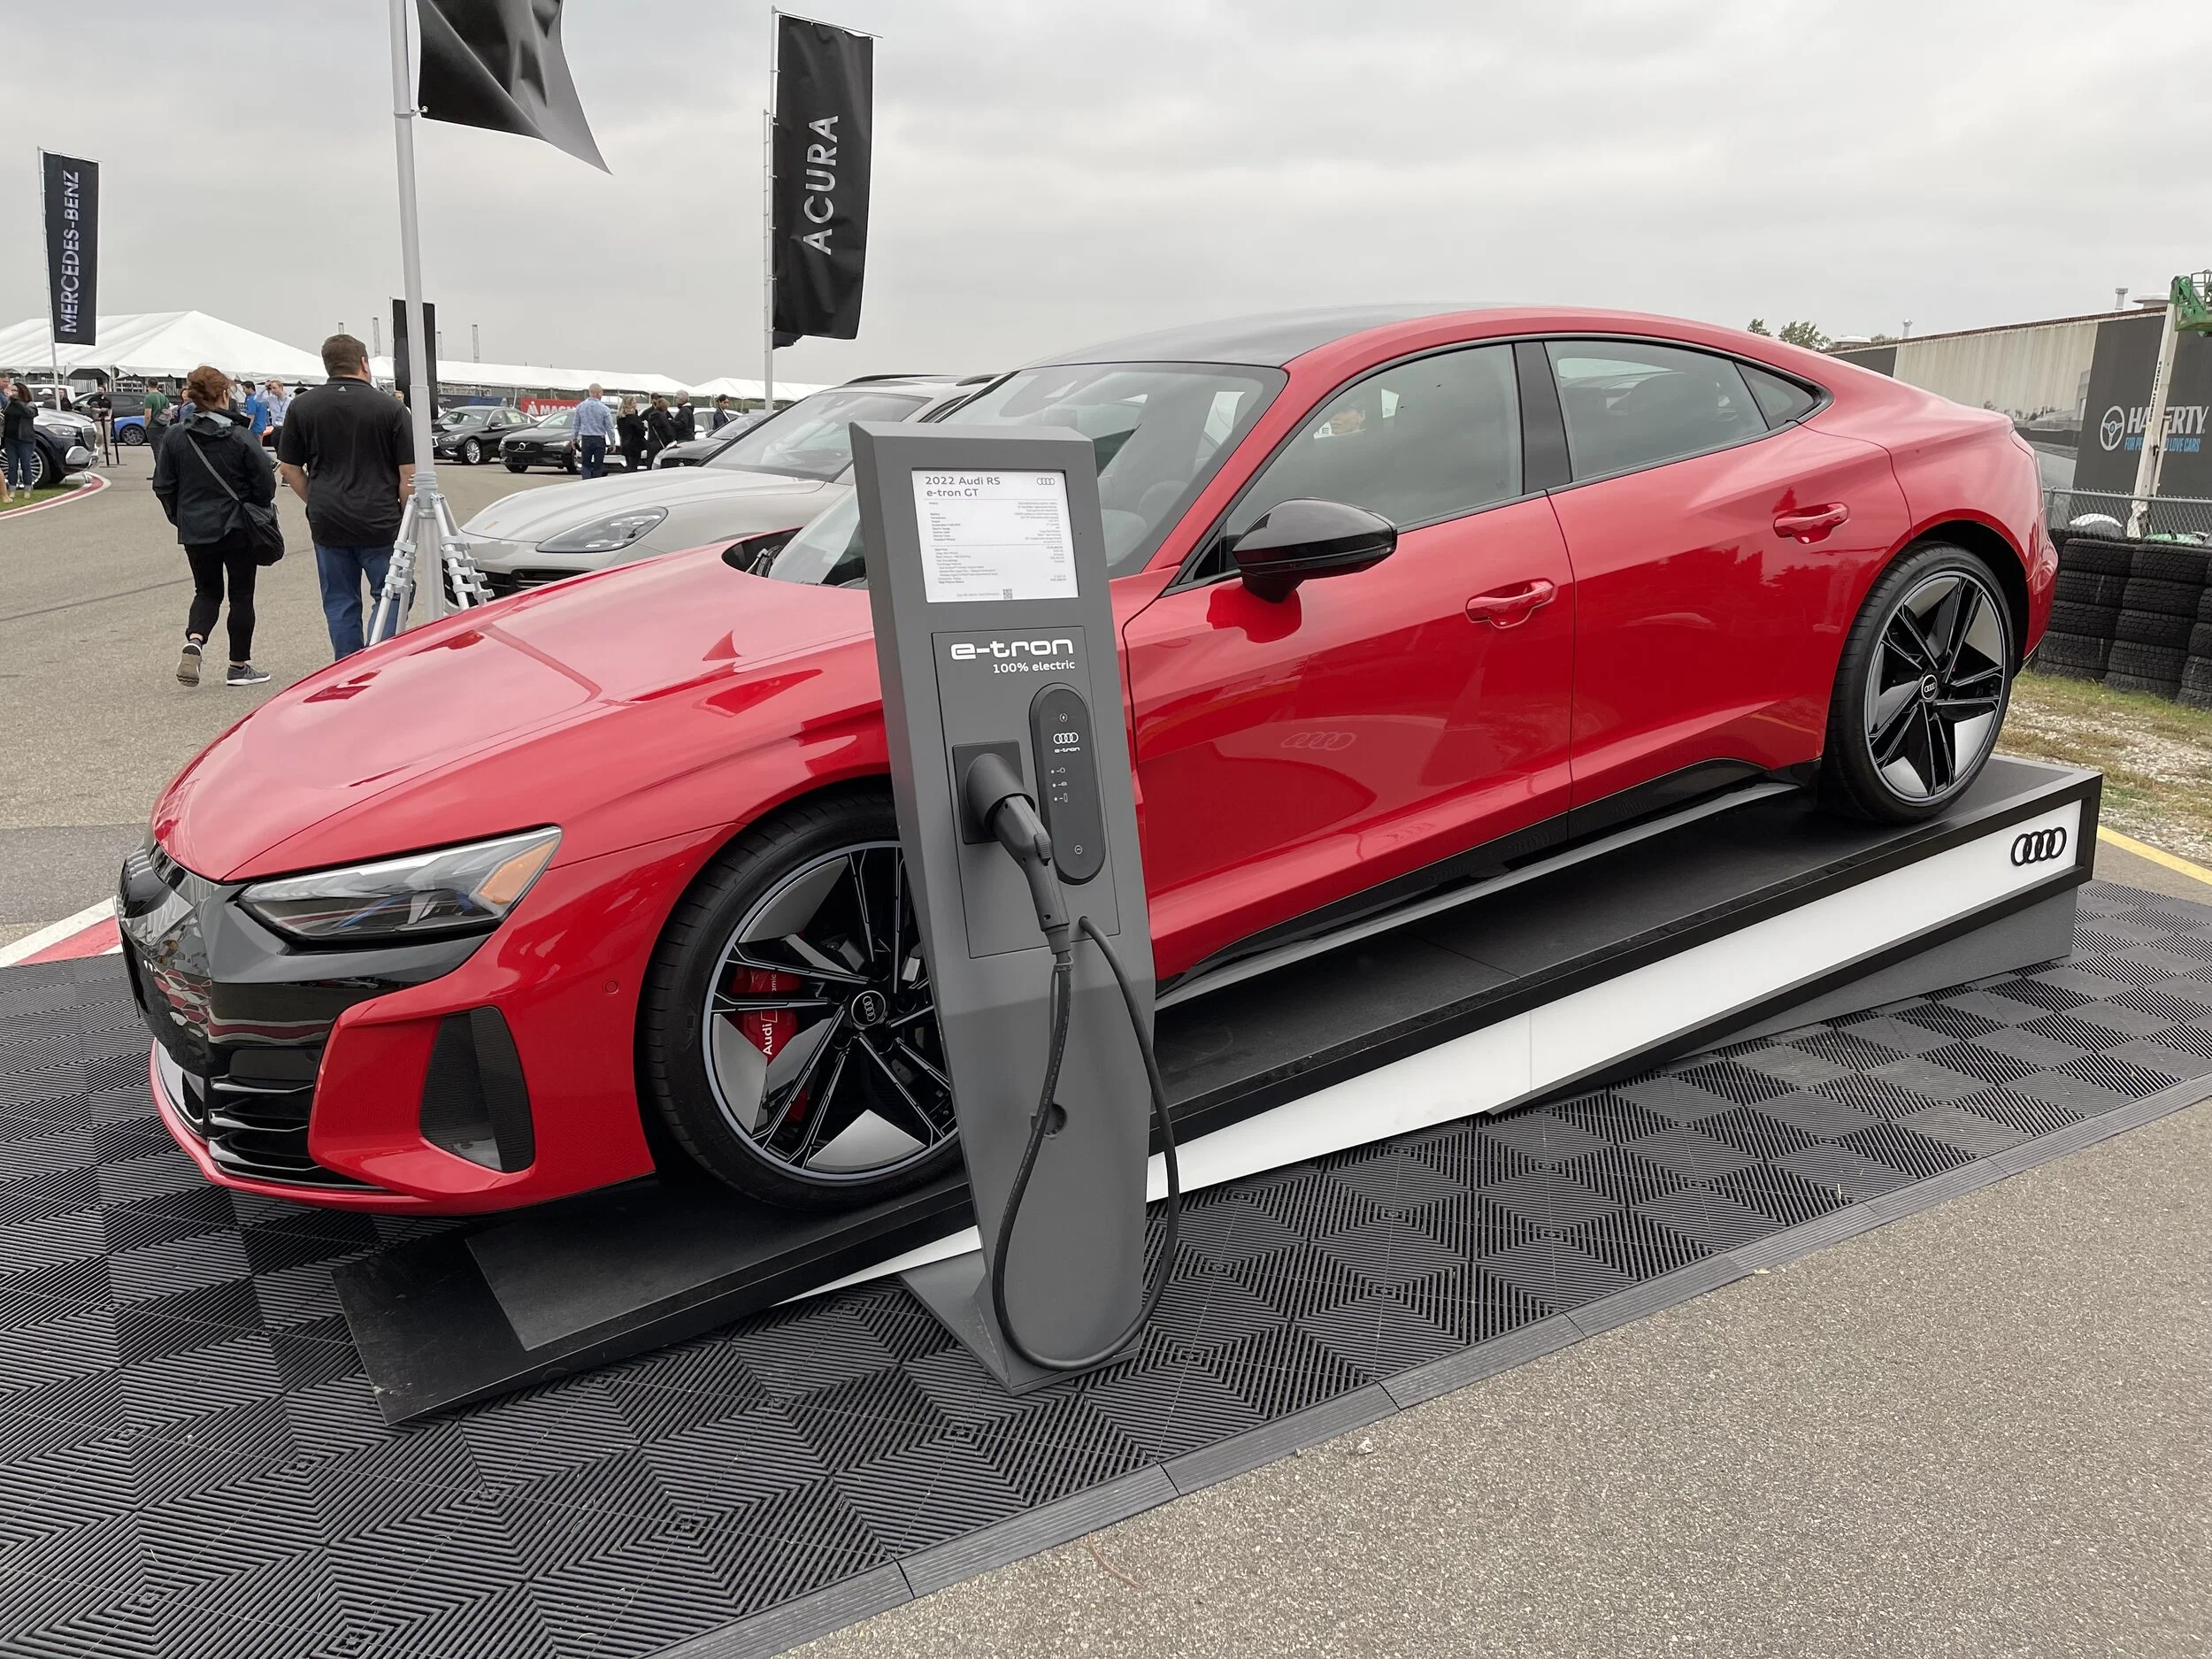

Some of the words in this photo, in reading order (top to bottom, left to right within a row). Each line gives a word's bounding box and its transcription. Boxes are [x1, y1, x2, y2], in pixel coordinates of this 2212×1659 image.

[802, 114, 839, 256] ACURA
[59, 169, 80, 334] MERCEDES-BENZ
[540, 404, 577, 415] MAG
[2126, 405, 2209, 434] HAERTY
[2169, 437, 2185, 452] LOVE
[2185, 438, 2200, 452] CARS
[925, 476, 956, 486] 2022
[958, 476, 984, 486] Audi
[987, 476, 1001, 486] RS
[926, 488, 962, 497] e-tron
[964, 488, 979, 497] GT
[950, 638, 1074, 660] e-tron
[993, 663, 1029, 674] 100%
[1032, 660, 1076, 672] electric
[762, 1023, 772, 1056] Audi
